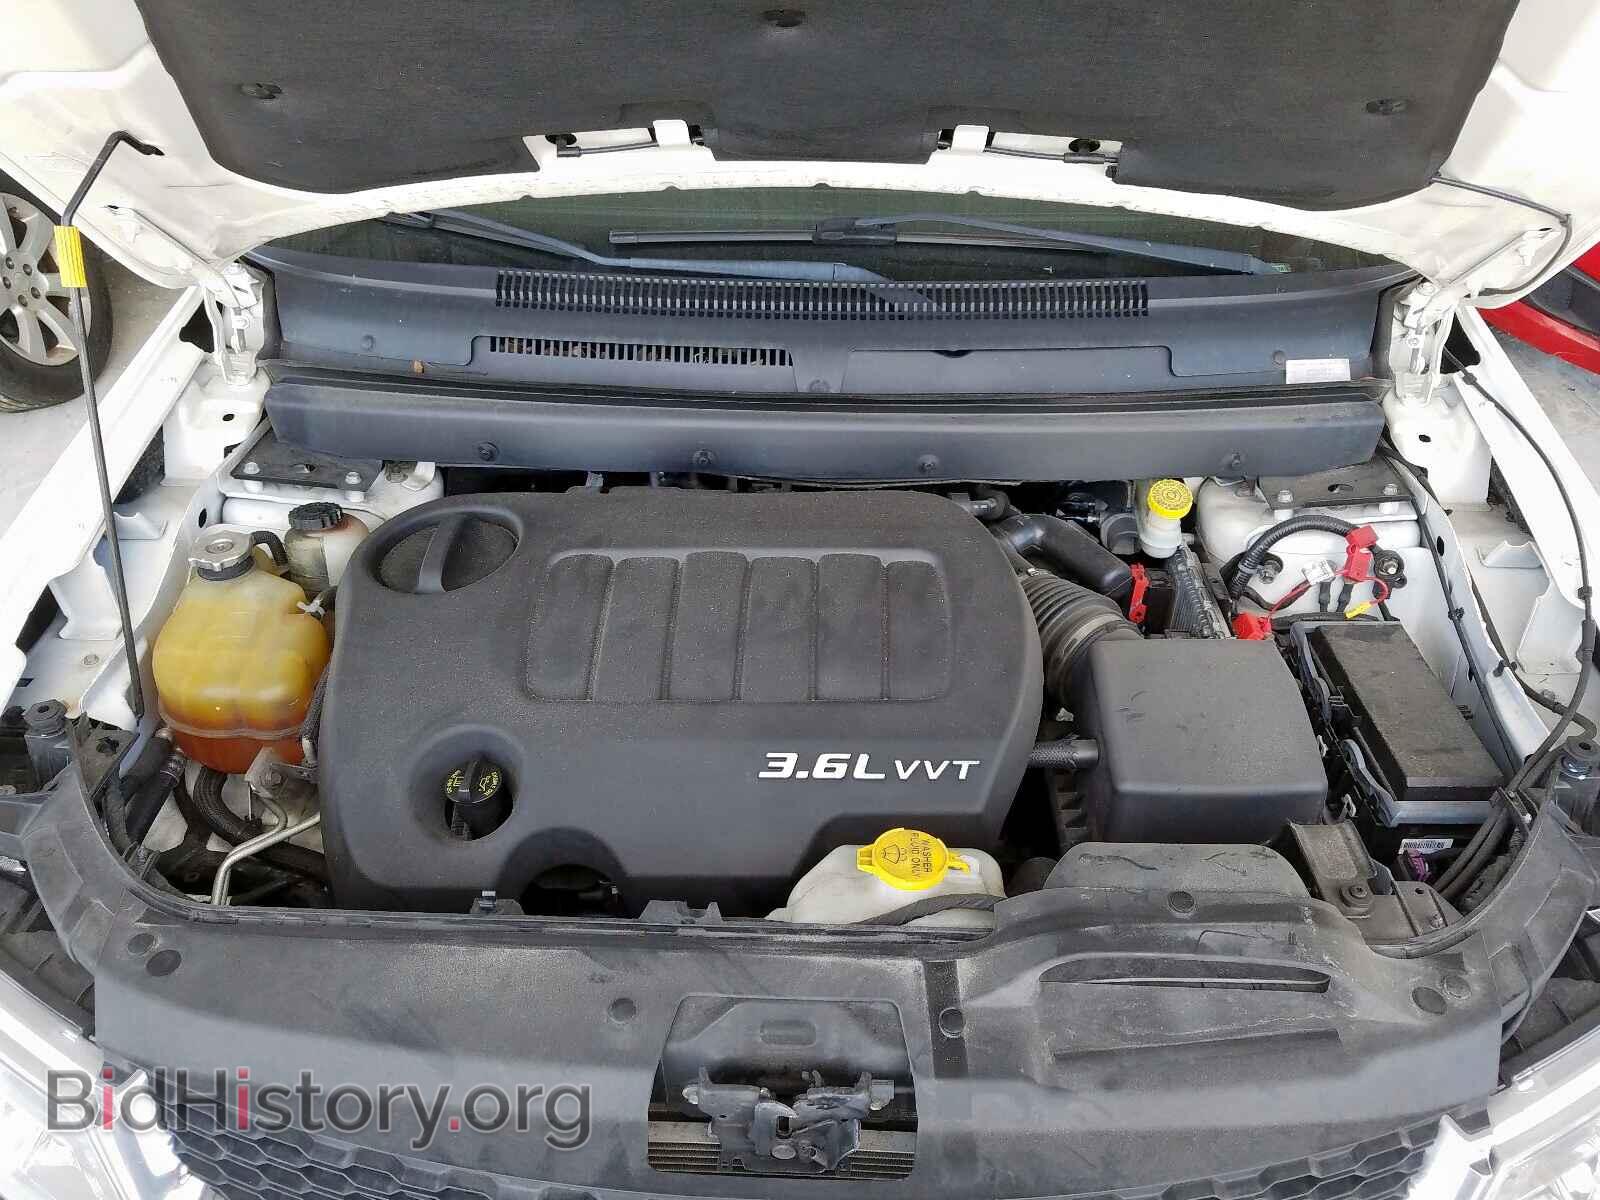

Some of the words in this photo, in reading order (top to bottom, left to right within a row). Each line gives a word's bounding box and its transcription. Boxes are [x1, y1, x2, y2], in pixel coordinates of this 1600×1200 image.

[758, 752, 886, 779] 3.6L
[894, 760, 981, 780] VVT
[910, 832, 920, 855] FLUID
[921, 838, 933, 873] WASHER
[911, 857, 921, 878] ONLY
